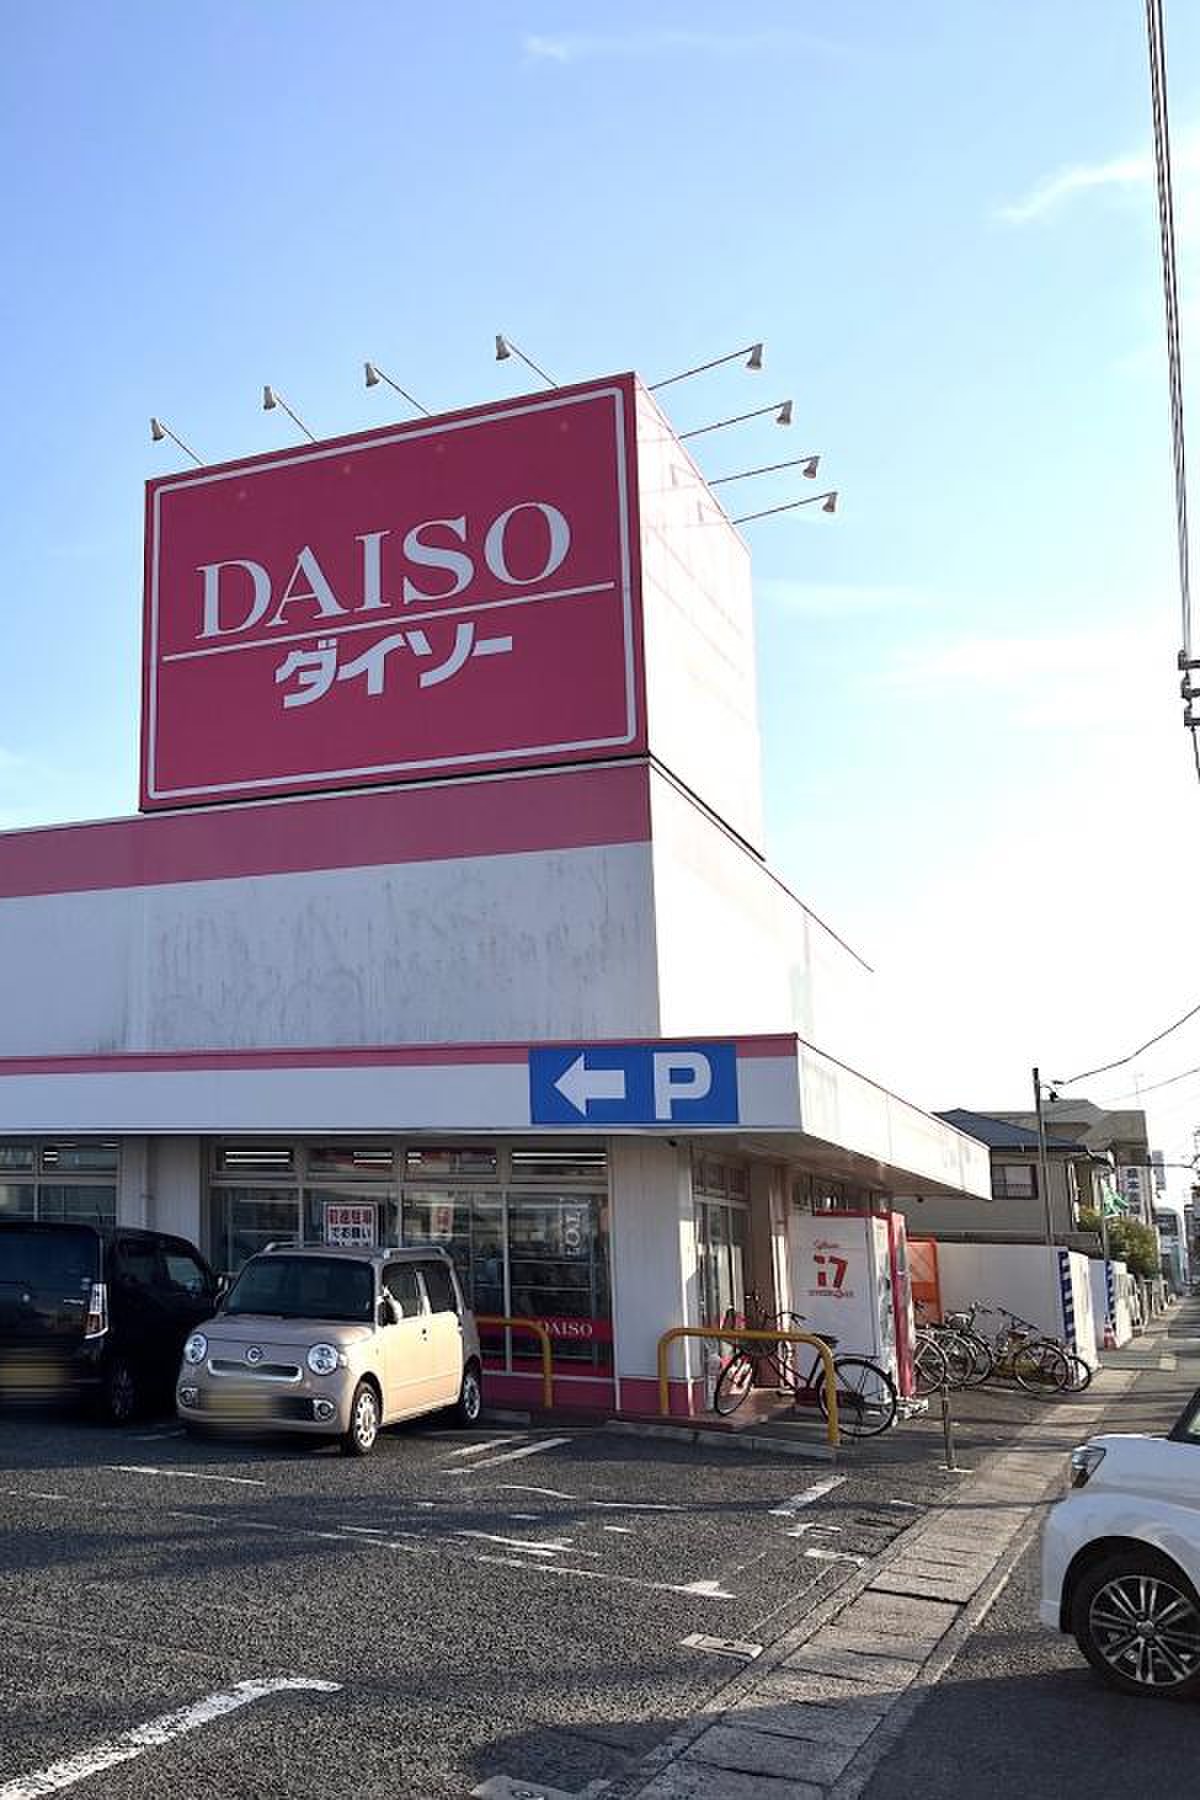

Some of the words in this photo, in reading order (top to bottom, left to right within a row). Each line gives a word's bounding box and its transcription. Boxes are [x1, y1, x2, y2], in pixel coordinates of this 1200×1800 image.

[195, 501, 571, 640] DAISO
[274, 621, 514, 709] ダイソー
[653, 1051, 713, 1120] P
